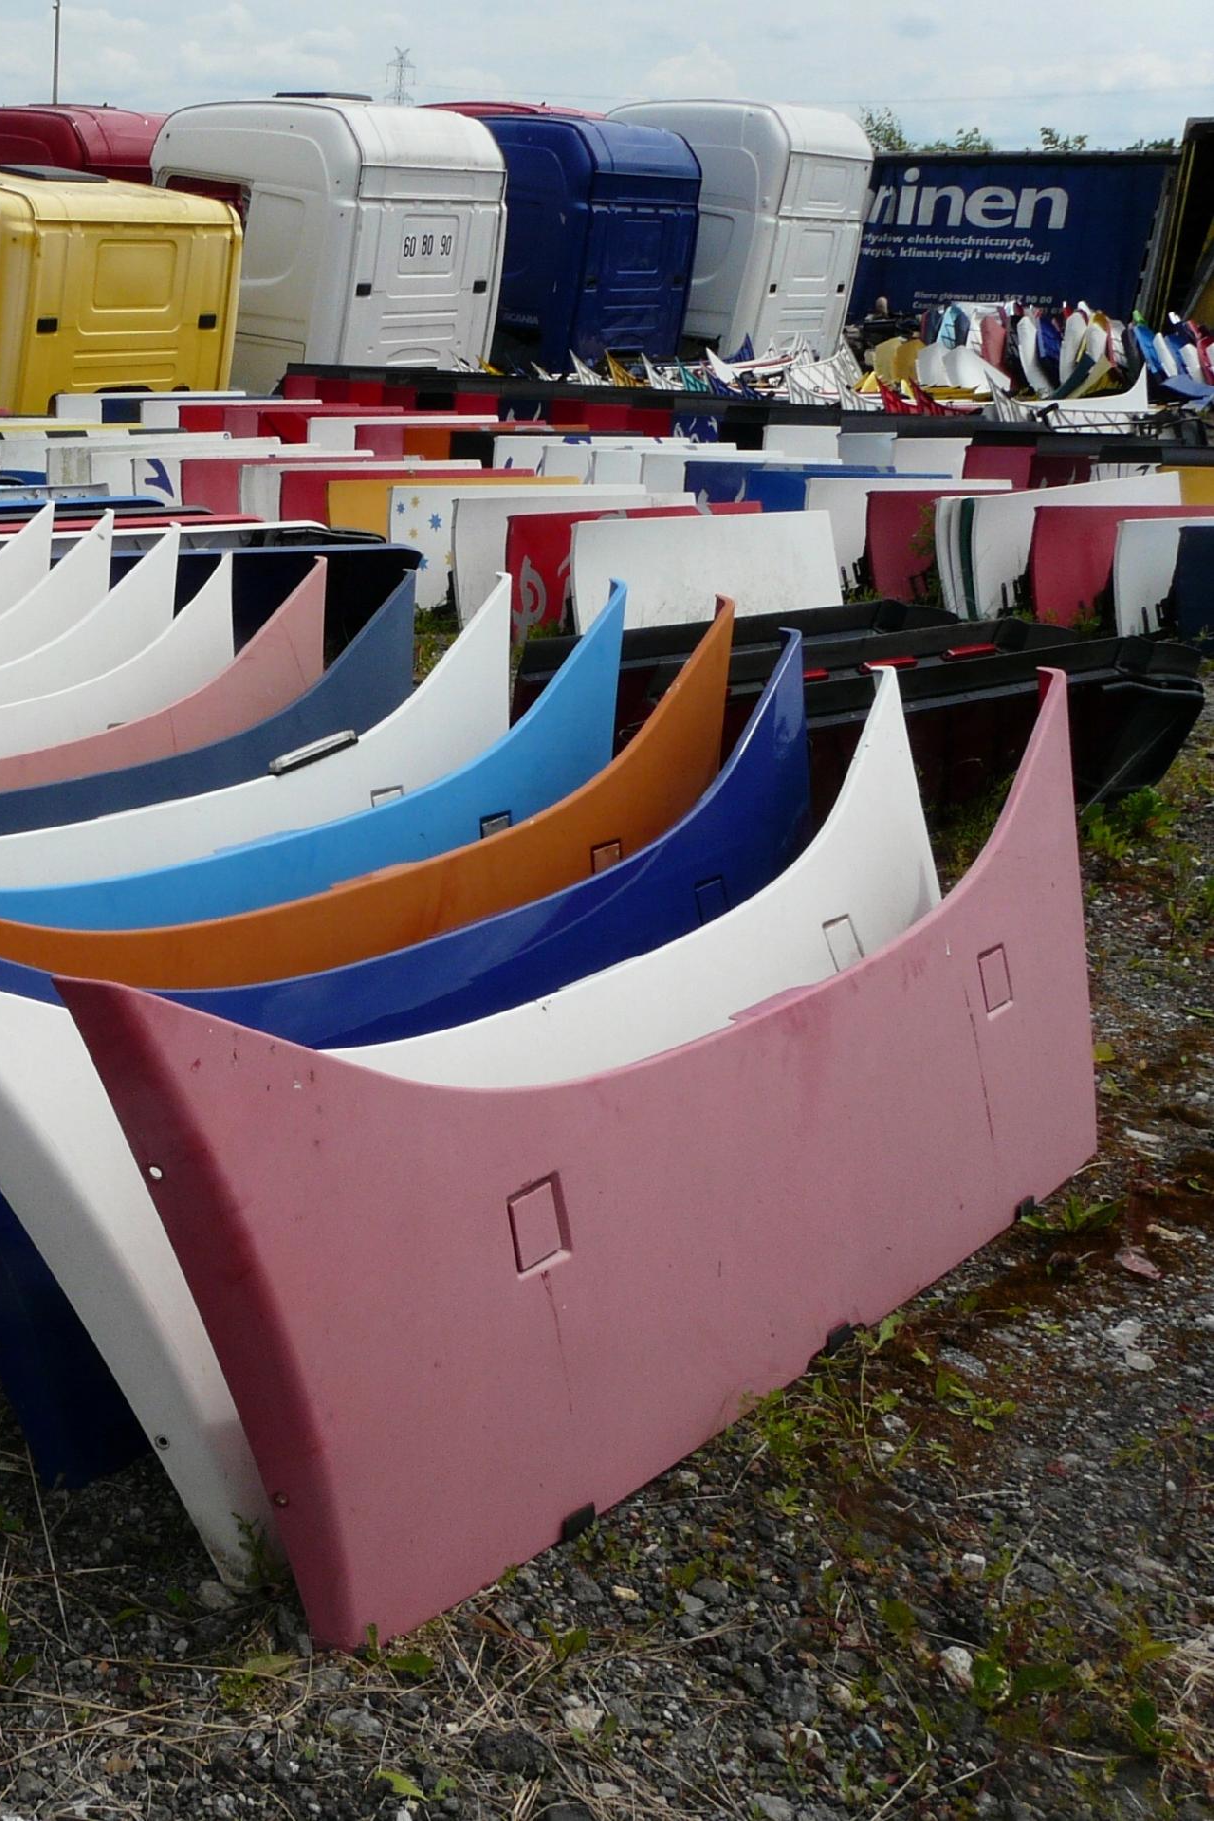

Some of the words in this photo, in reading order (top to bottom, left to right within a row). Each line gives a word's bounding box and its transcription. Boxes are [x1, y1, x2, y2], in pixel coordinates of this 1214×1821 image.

[403, 236, 416, 257] 60
[421, 235, 434, 255] 80
[440, 235, 452, 256] 90
[907, 234, 1034, 249] elektrotechnicznych,
[899, 247, 973, 262] klimatyzacji
[984, 251, 1051, 265] wentylacji
